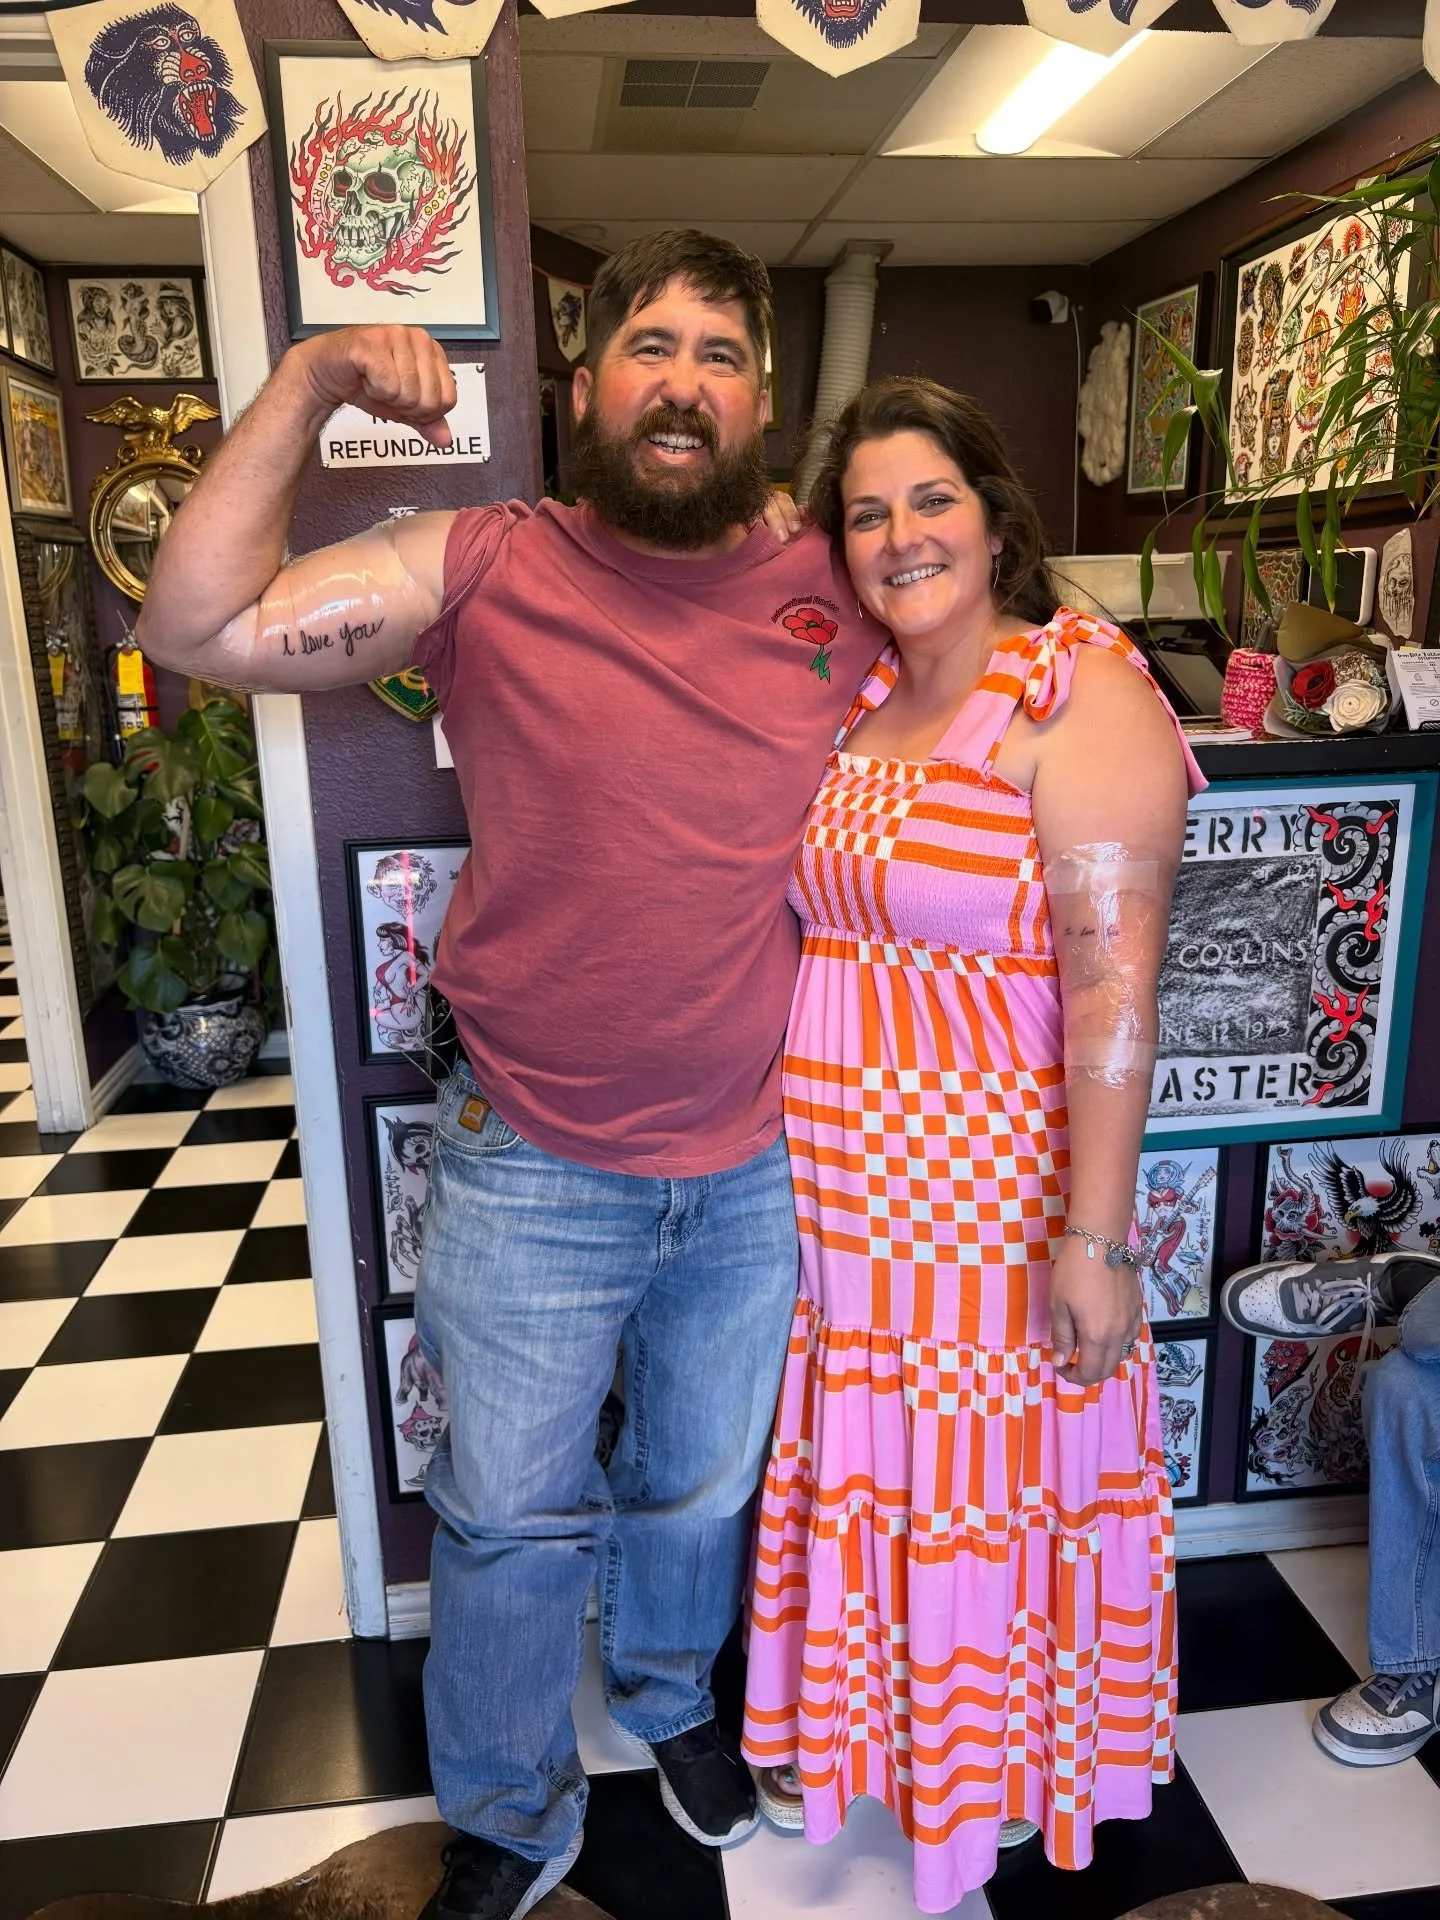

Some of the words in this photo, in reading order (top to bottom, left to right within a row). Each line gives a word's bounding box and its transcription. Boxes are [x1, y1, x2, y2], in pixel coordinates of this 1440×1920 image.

[316, 153, 335, 188] IRON
[312, 188, 325, 219] RITE
[401, 199, 440, 246] TATTOO
[300, 630, 334, 655] love
[1183, 813, 1298, 858] ERRY
[1178, 939, 1308, 969] COLLINS
[1157, 1062, 1313, 1104] ASTER
